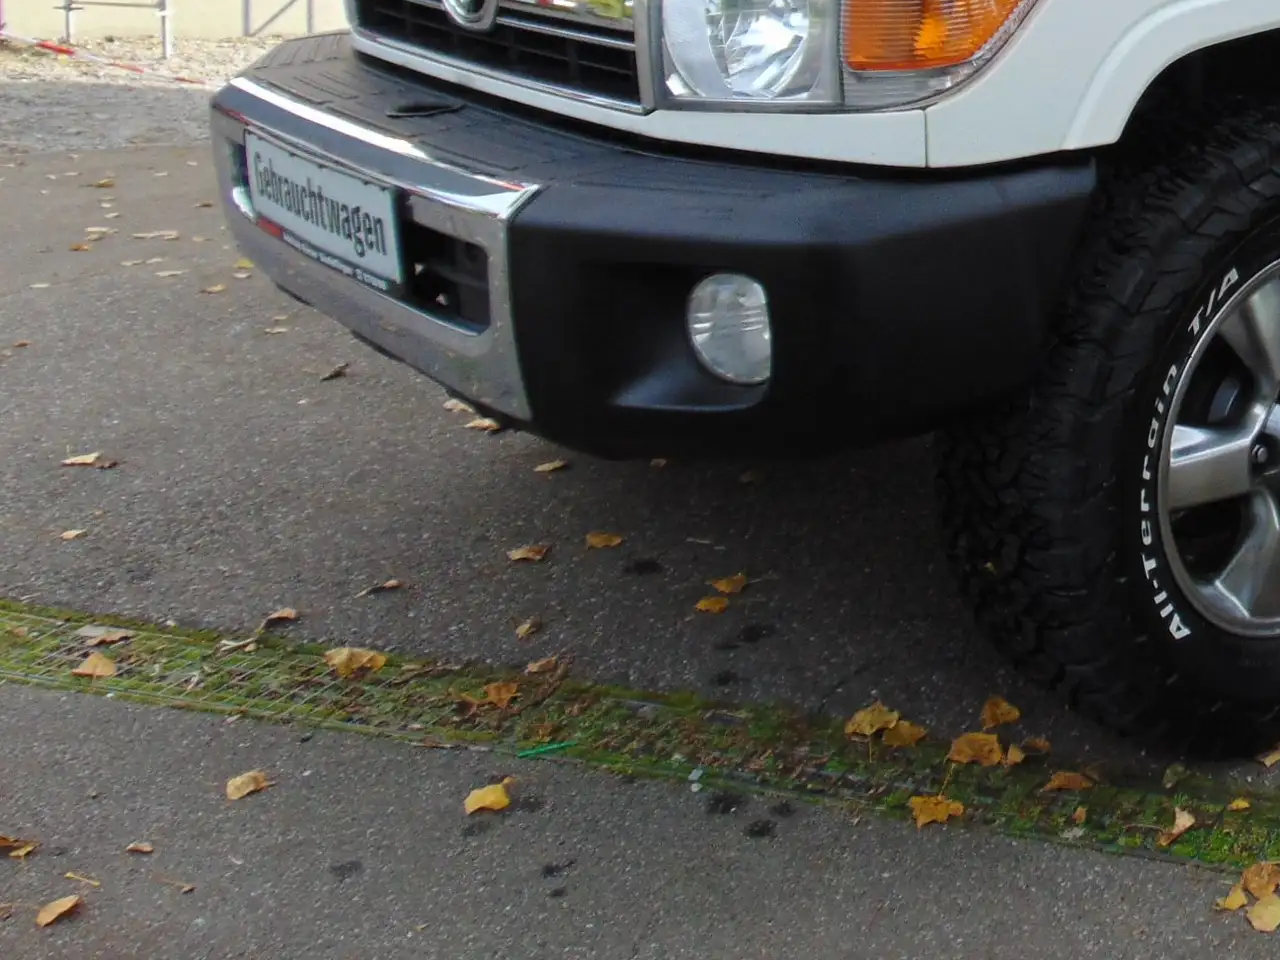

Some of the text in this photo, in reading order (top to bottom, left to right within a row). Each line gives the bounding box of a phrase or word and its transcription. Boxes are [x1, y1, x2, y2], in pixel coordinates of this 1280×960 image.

[254, 151, 387, 258] Gebrauchtwagen
[1139, 267, 1240, 641] All-Terrain T/A
